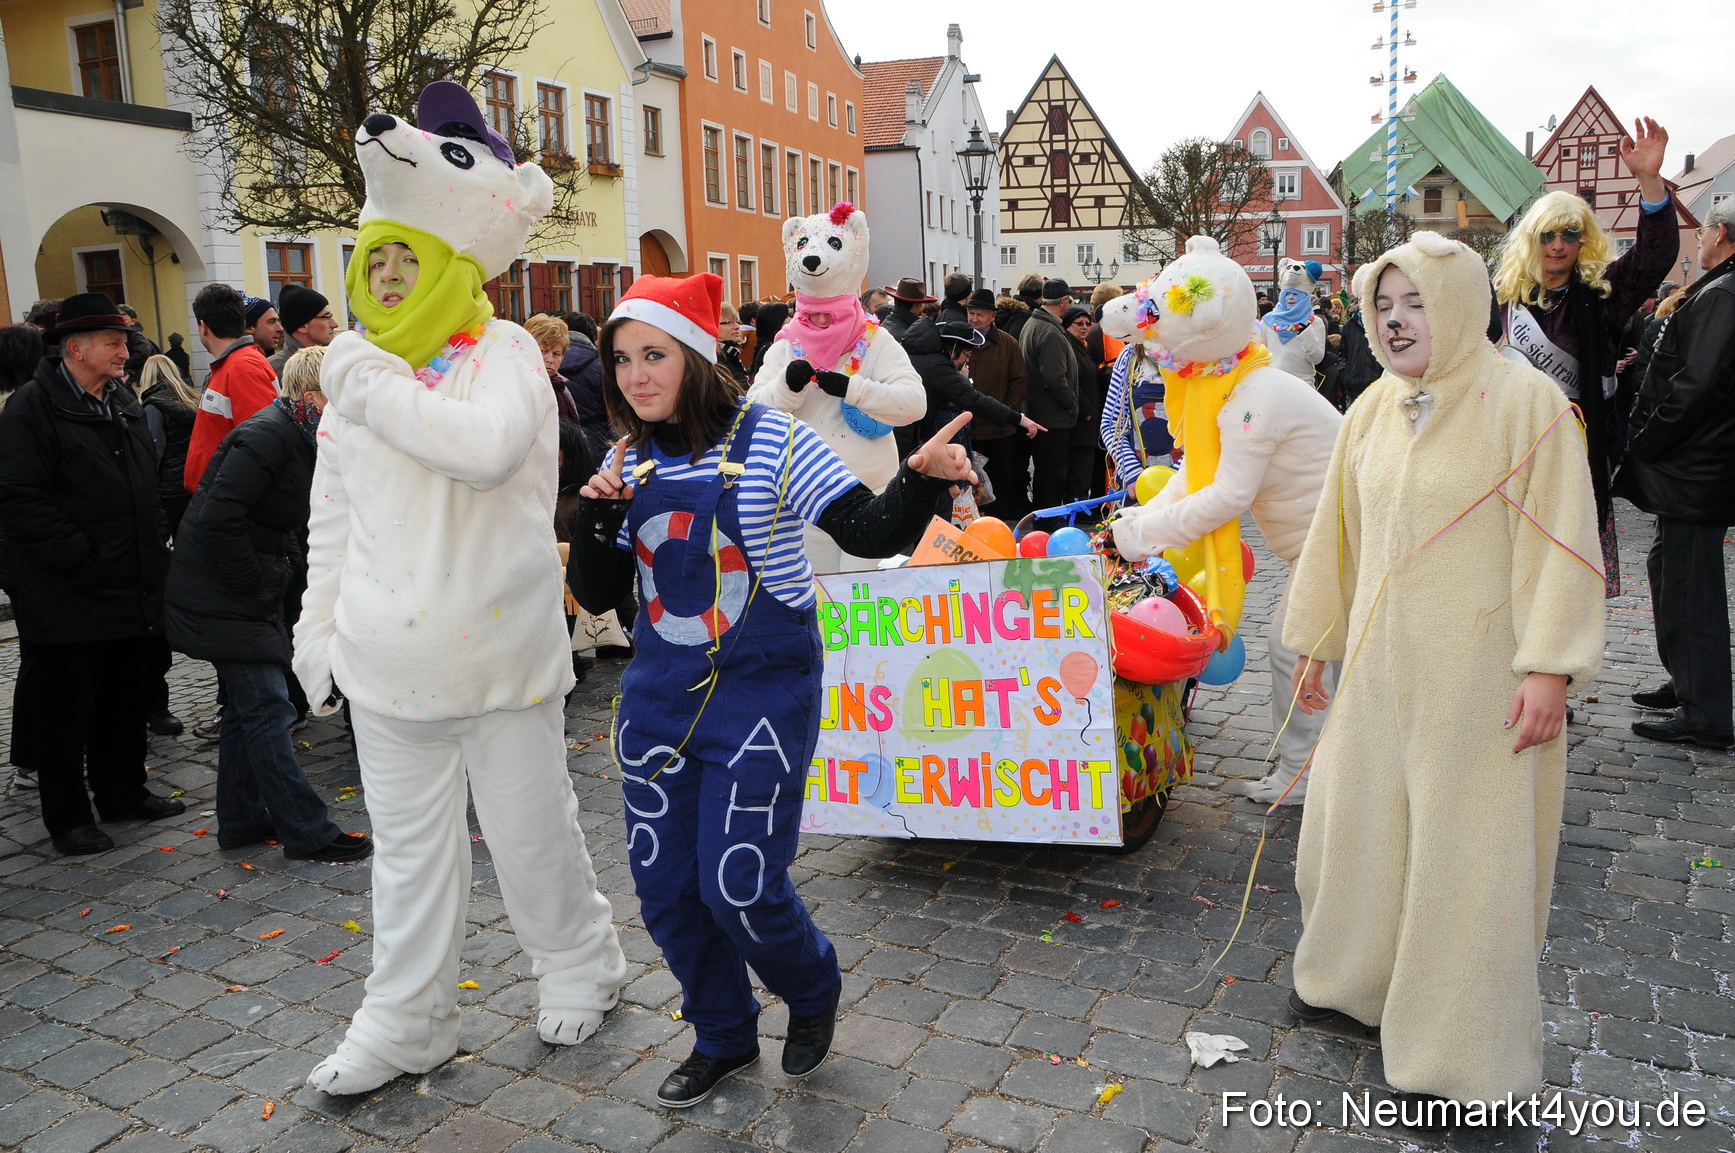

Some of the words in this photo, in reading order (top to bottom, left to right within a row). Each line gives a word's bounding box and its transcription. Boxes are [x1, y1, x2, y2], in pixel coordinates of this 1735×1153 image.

[1512, 322, 1531, 346] die
[1526, 344, 1554, 370] sich
[932, 533, 984, 562] BERC
[921, 666, 1063, 729] HAT'S
[717, 716, 791, 944] AHOI
